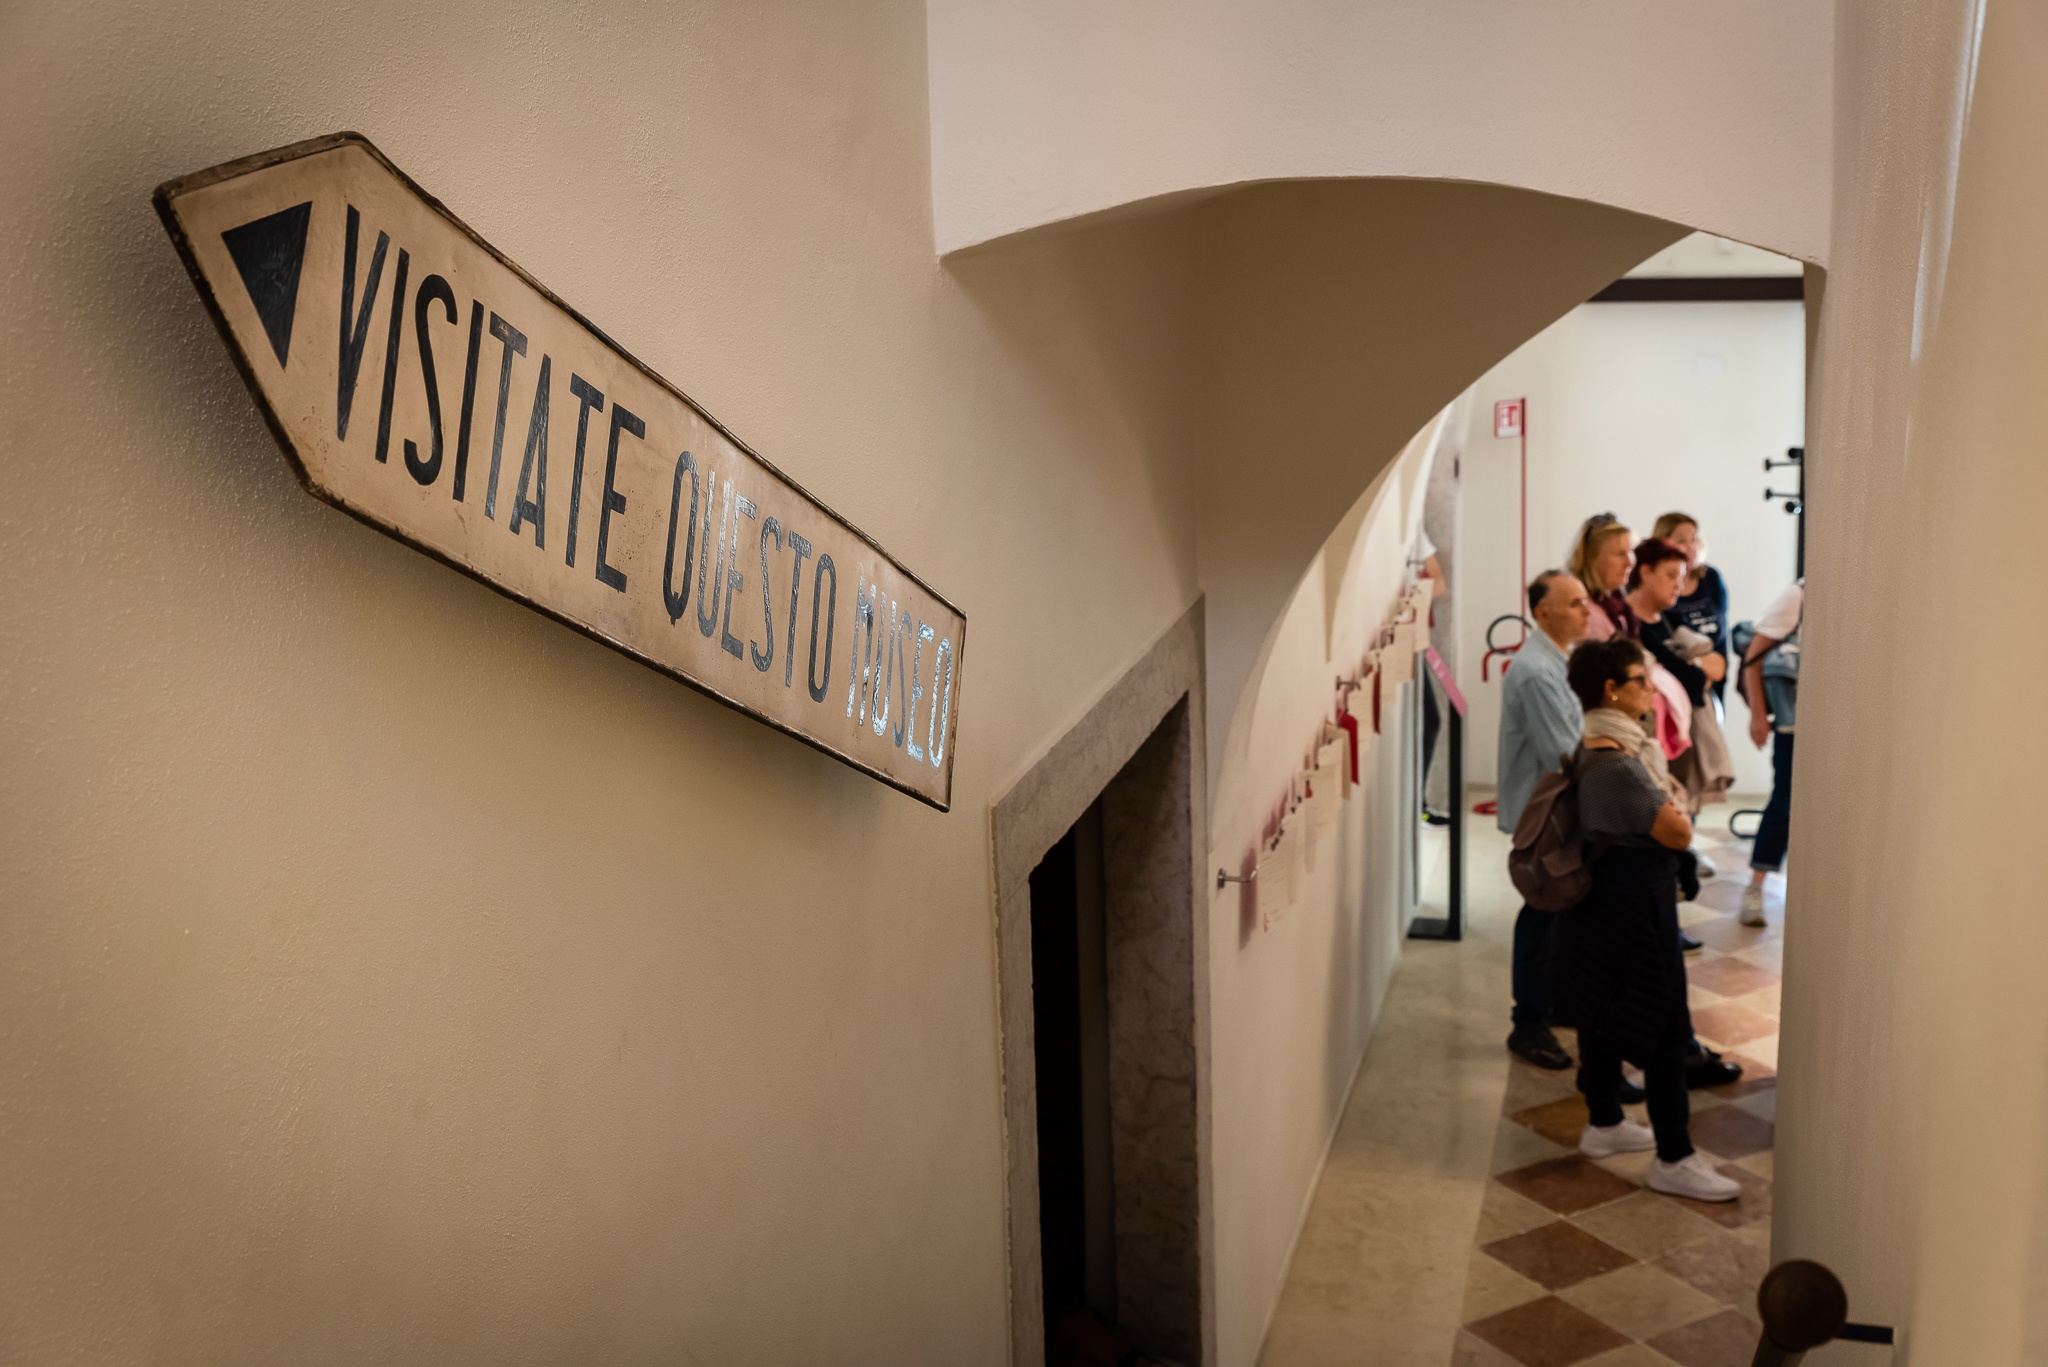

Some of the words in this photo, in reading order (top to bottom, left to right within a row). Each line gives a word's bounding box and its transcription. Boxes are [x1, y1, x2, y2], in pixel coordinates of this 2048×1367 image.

[336, 203, 646, 593] VISITATE
[663, 451, 836, 703] QUESTO
[846, 577, 952, 769] MUSEO
